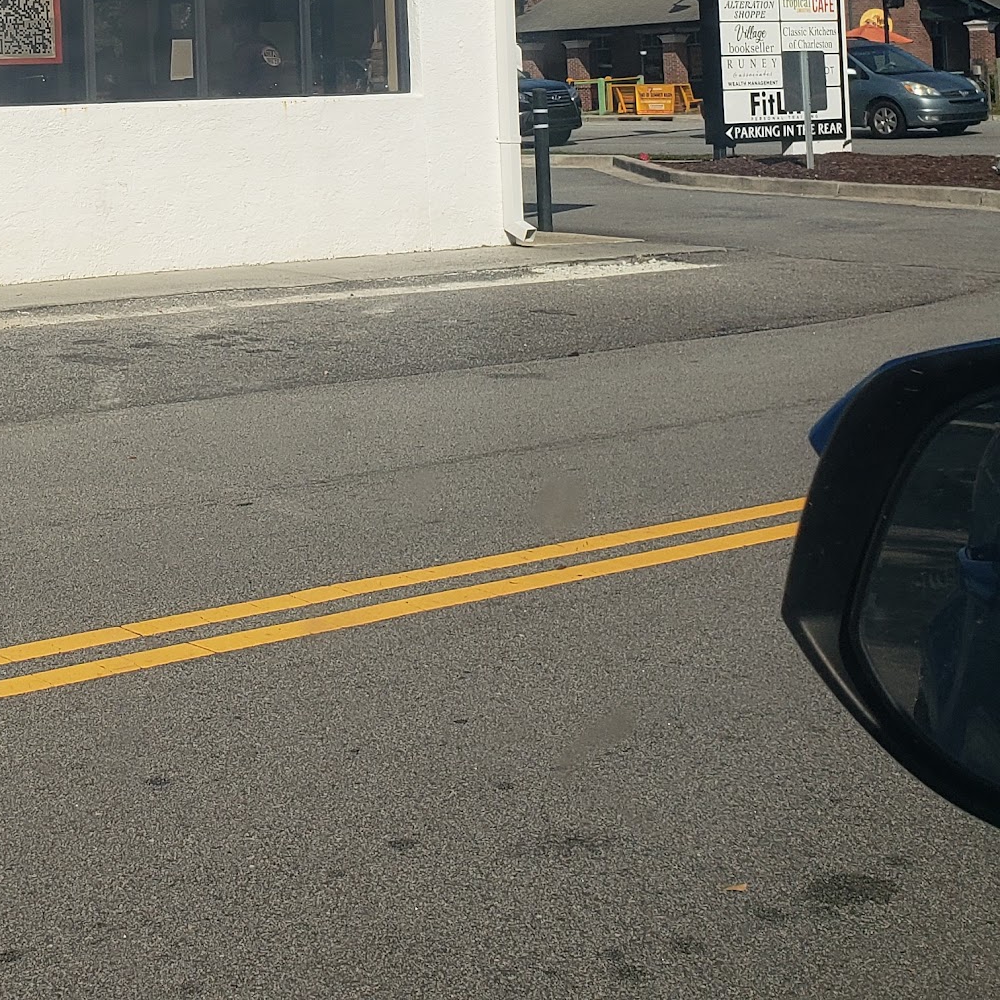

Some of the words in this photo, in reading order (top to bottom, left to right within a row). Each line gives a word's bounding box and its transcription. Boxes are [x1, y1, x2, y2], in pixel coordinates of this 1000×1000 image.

[724, 0, 775, 9] ALTERATION
[733, 10, 766, 19] SHOPPE
[734, 24, 767, 43] Village
[782, 27, 806, 37] Classic
[808, 27, 837, 37] Kitchens
[728, 42, 775, 54] bookseller
[788, 39, 797, 49] of
[797, 39, 833, 49] Charleston
[727, 58, 777, 69] RUNEY
[734, 125, 780, 139] PARKING
[783, 124, 794, 137] IN
[818, 122, 843, 135] REAR
